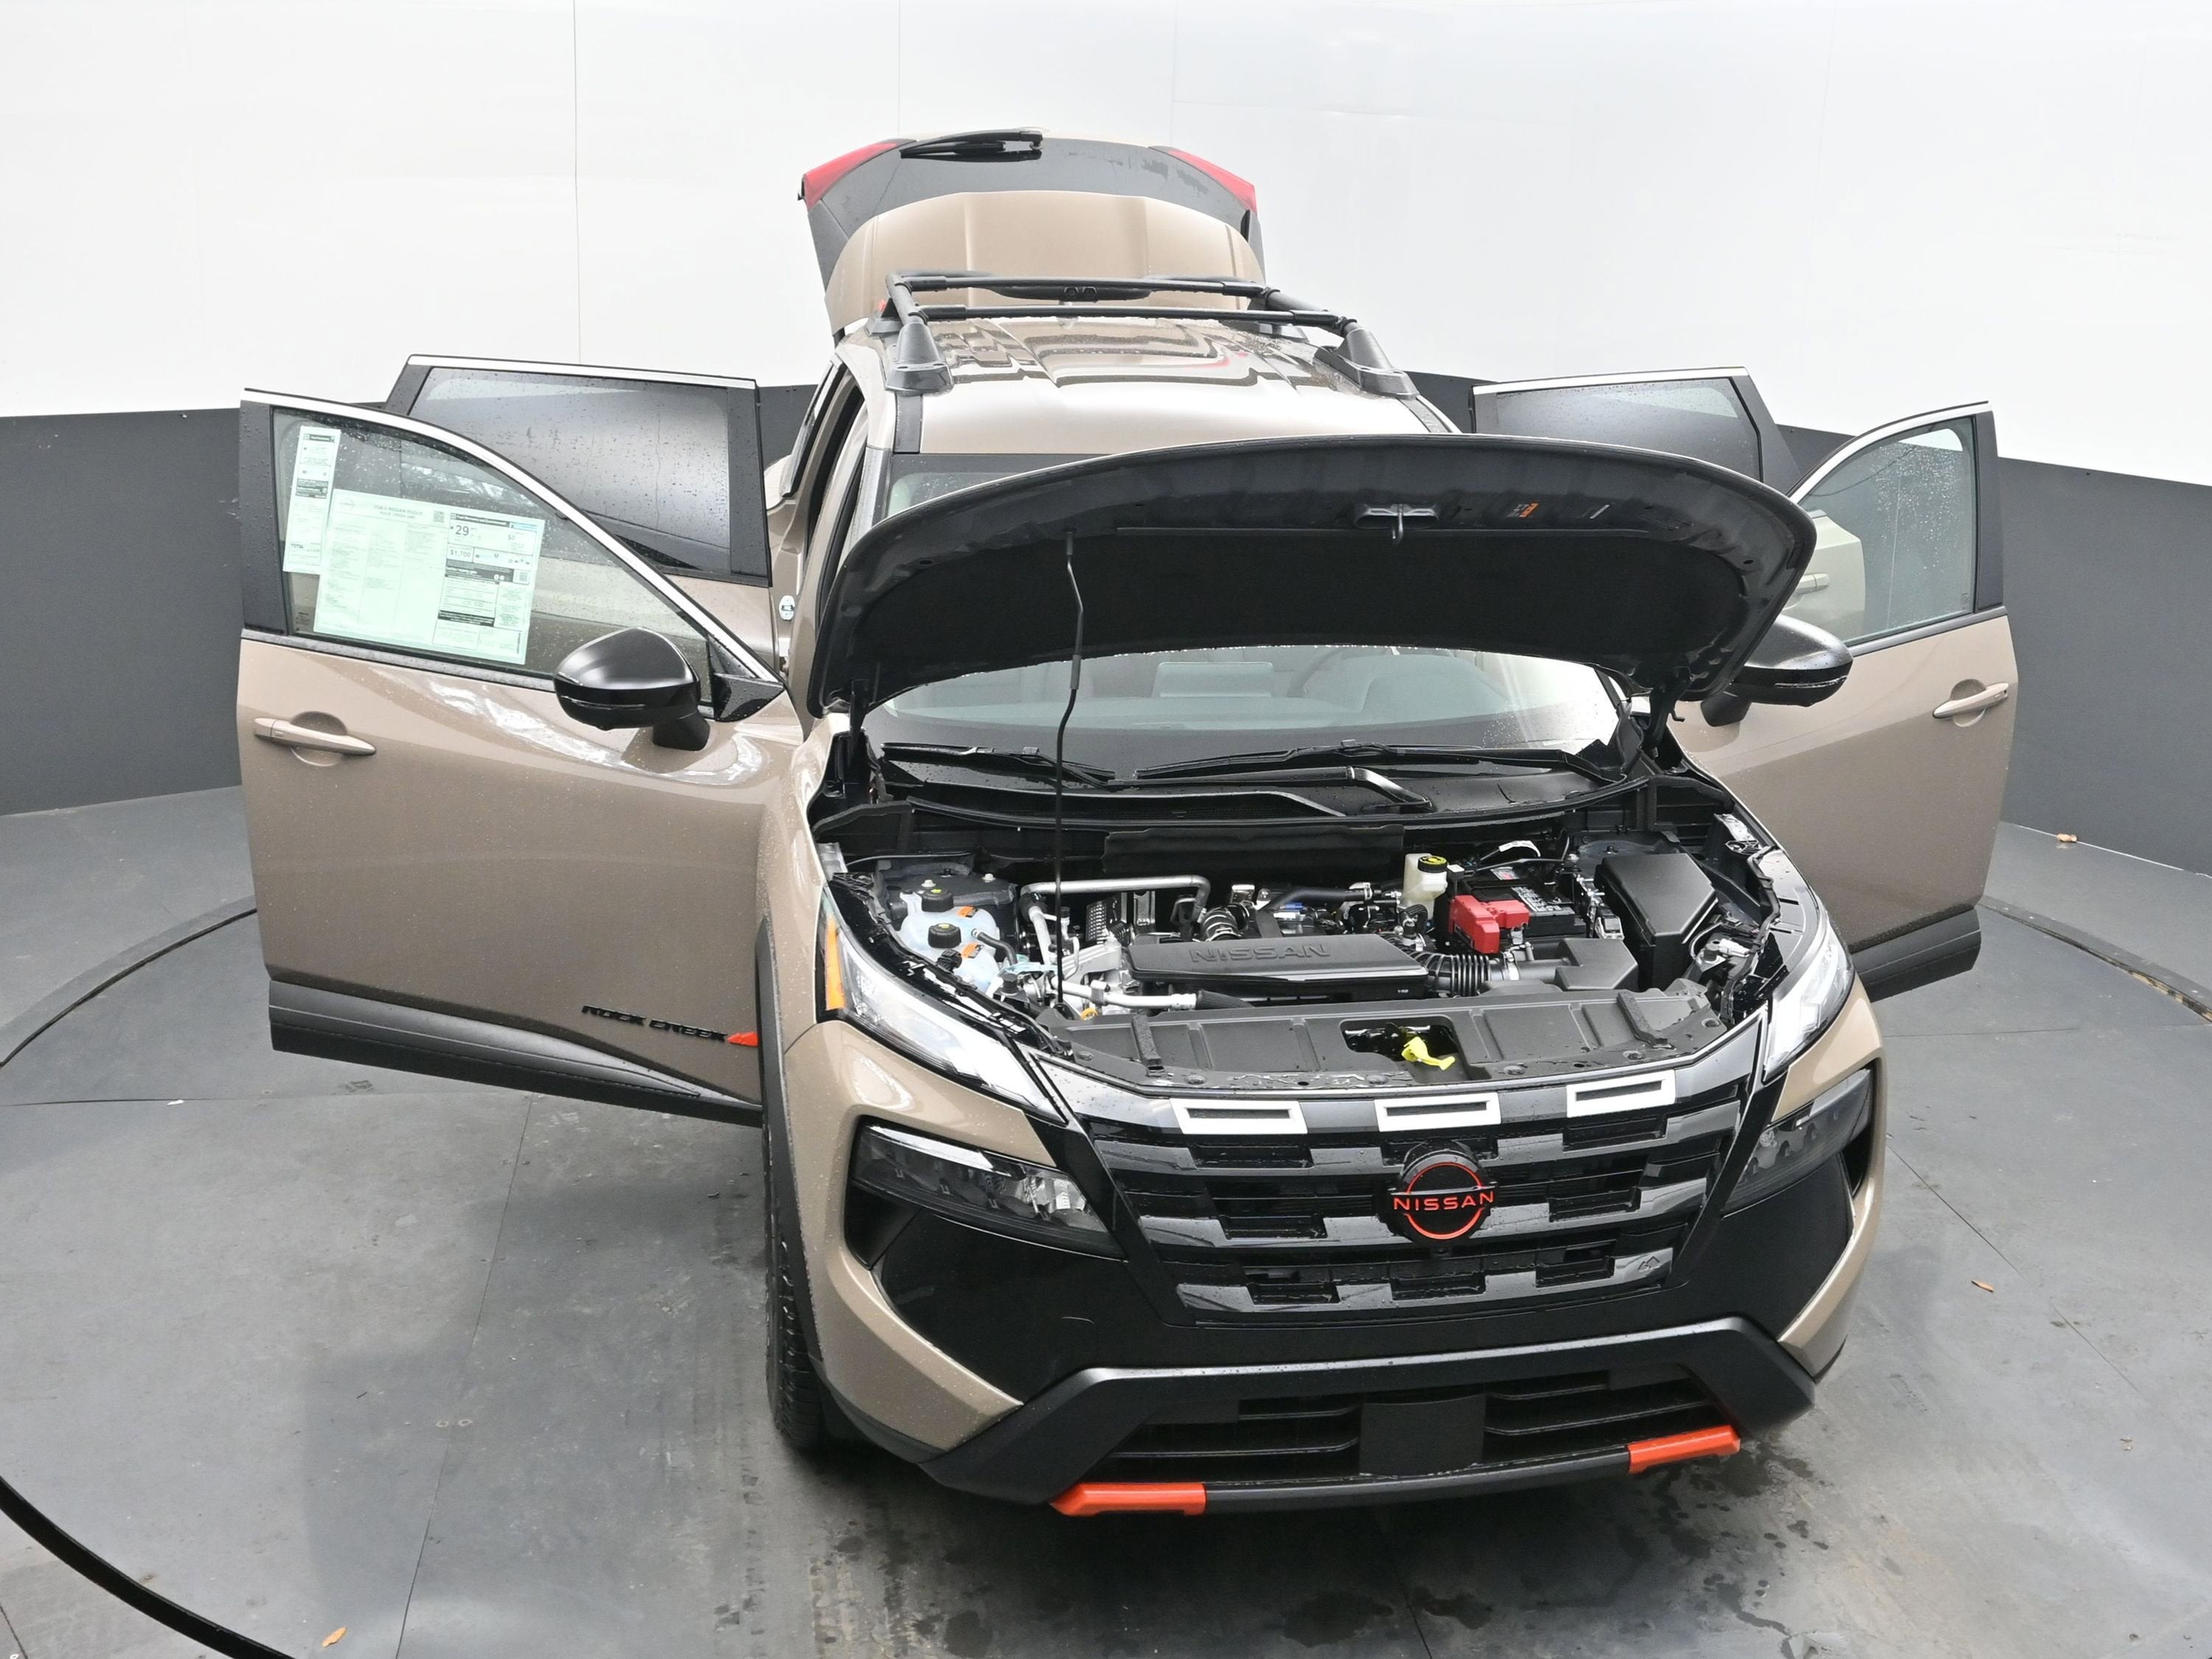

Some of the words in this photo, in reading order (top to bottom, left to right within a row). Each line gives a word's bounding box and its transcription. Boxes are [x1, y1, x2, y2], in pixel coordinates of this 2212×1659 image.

[455, 524, 470, 536] 29
[1189, 943, 1330, 964] NISSAN
[581, 1004, 647, 1027] ROCK
[1393, 1191, 1495, 1211] NISSAN
